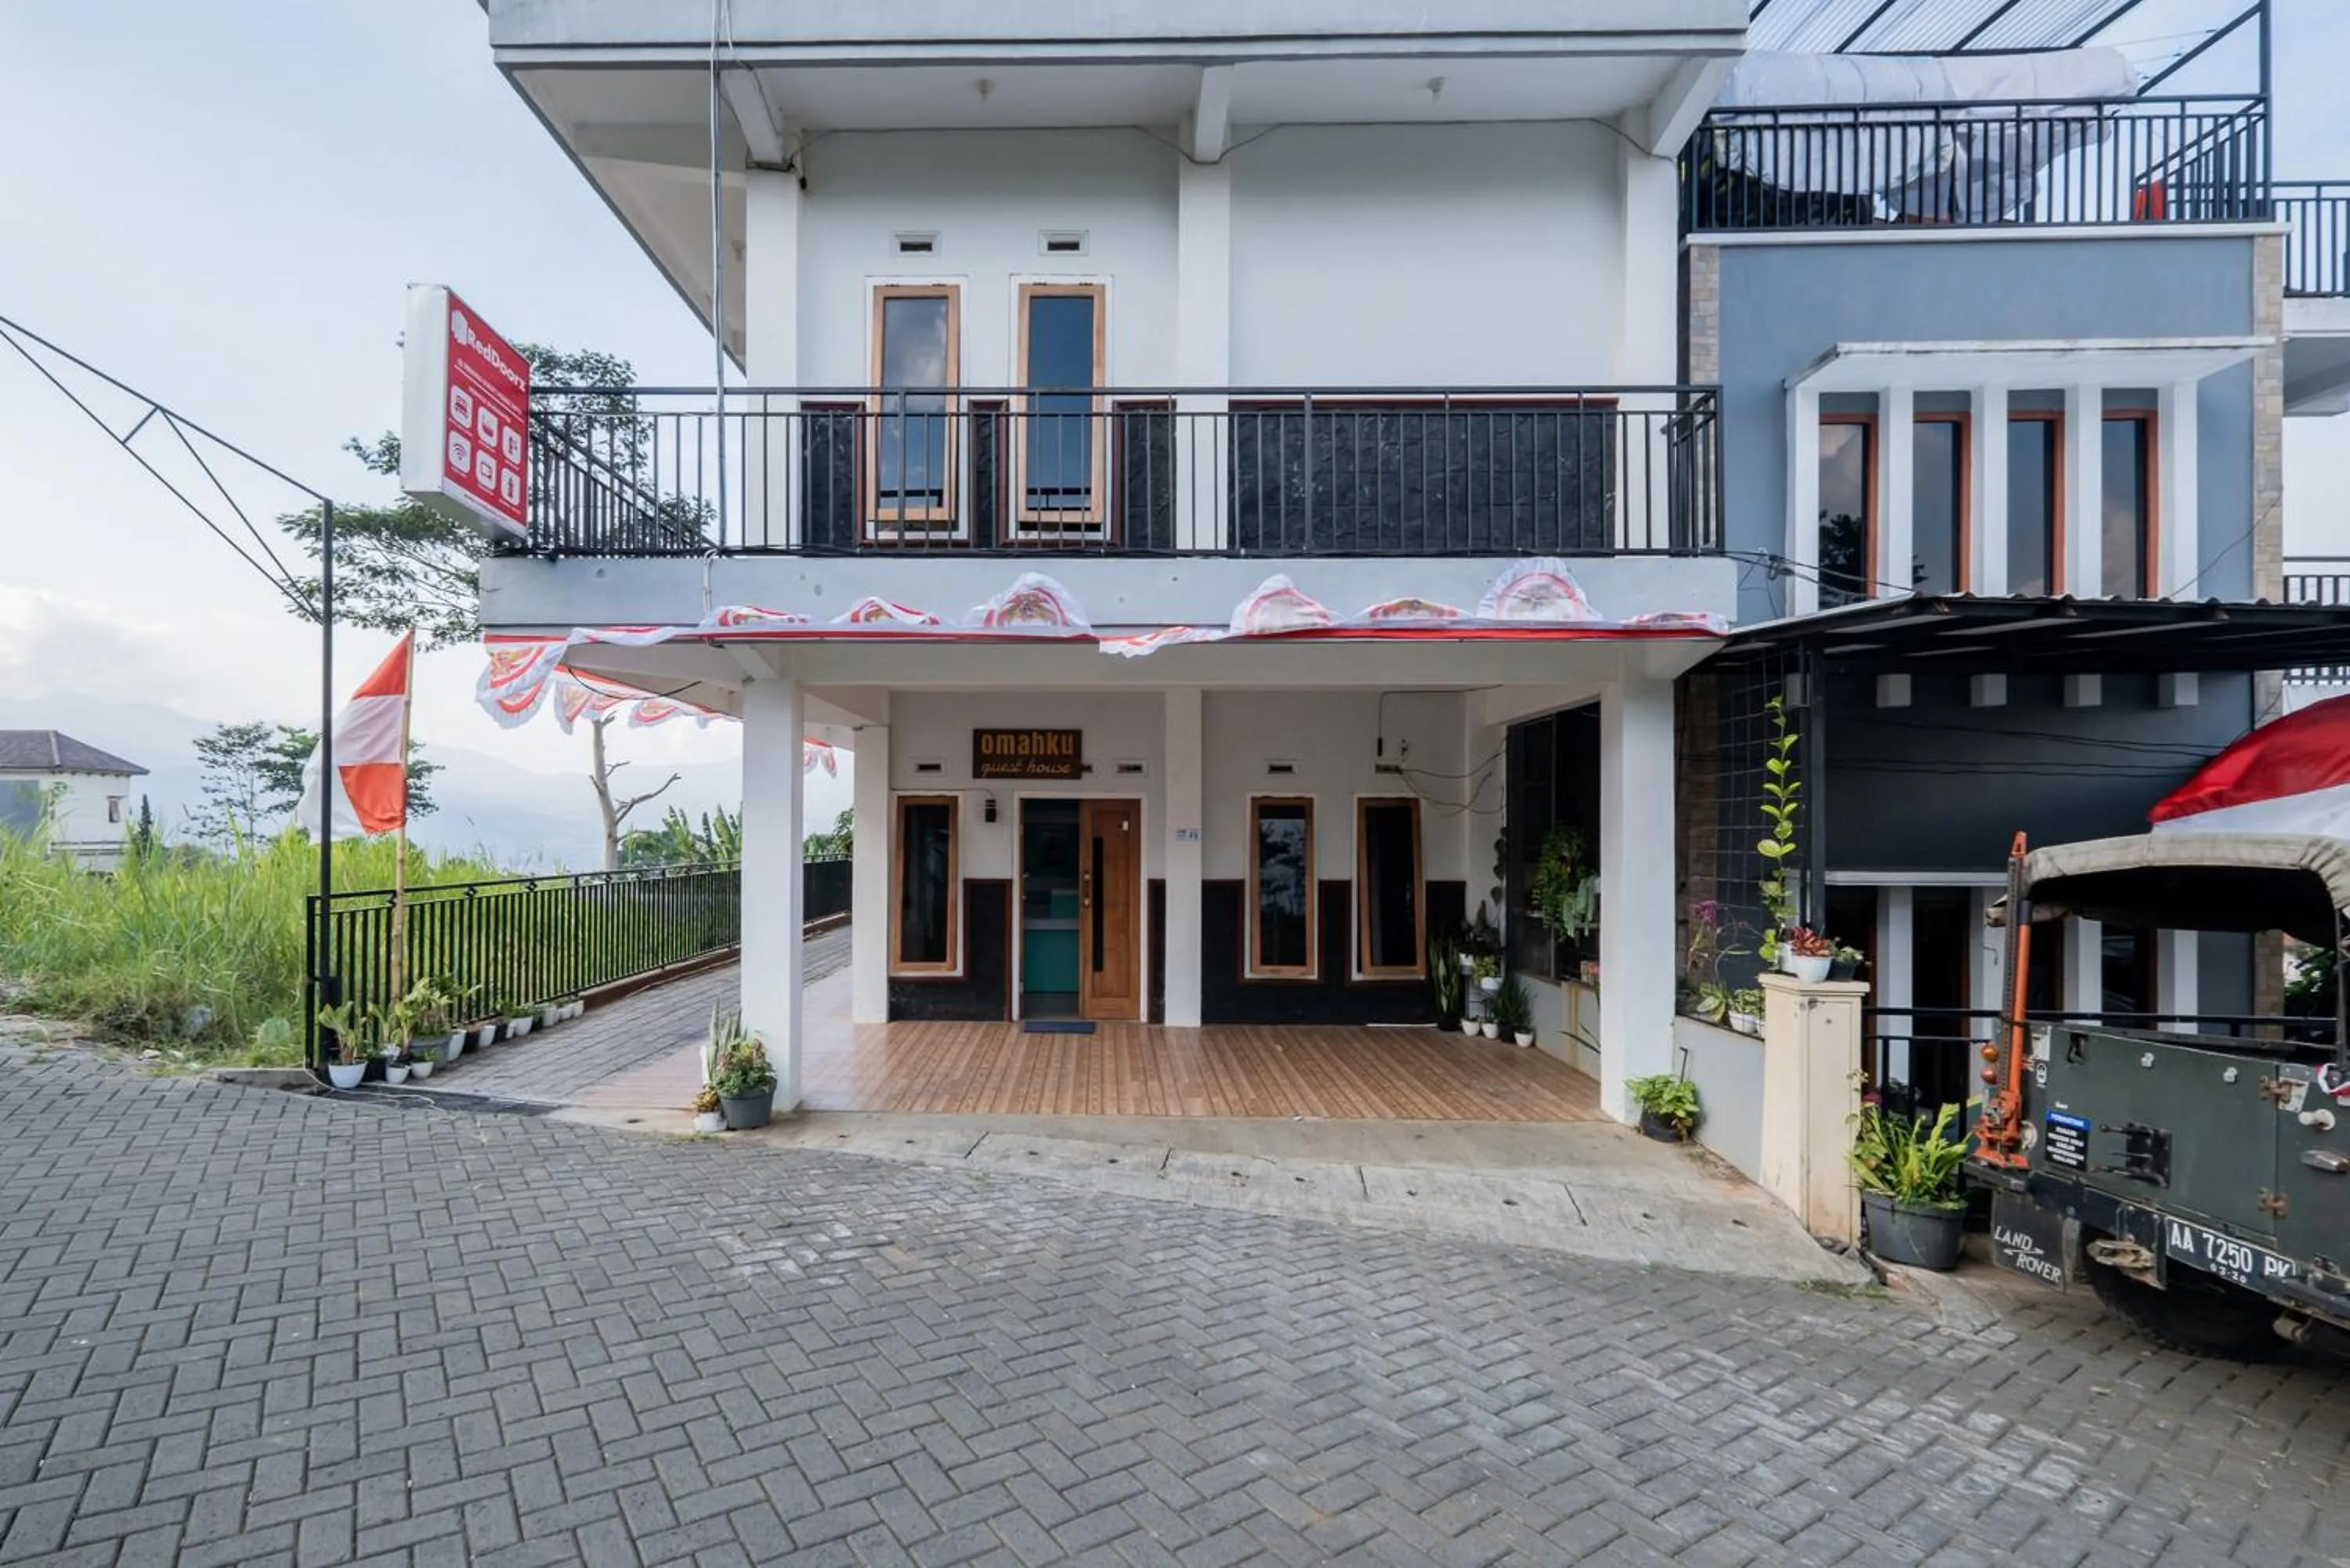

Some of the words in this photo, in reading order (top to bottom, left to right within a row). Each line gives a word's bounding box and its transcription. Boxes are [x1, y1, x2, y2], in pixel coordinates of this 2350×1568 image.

[468, 327, 526, 392] RedDoorz
[981, 731, 1074, 755] omahku
[981, 758, 1023, 777] guest
[1026, 757, 1072, 774] house
[1994, 1226, 2033, 1251] LAND
[2171, 1223, 2194, 1253] AA
[2202, 1232, 2253, 1273] 7250
[2016, 1252, 2062, 1283] ROVER
